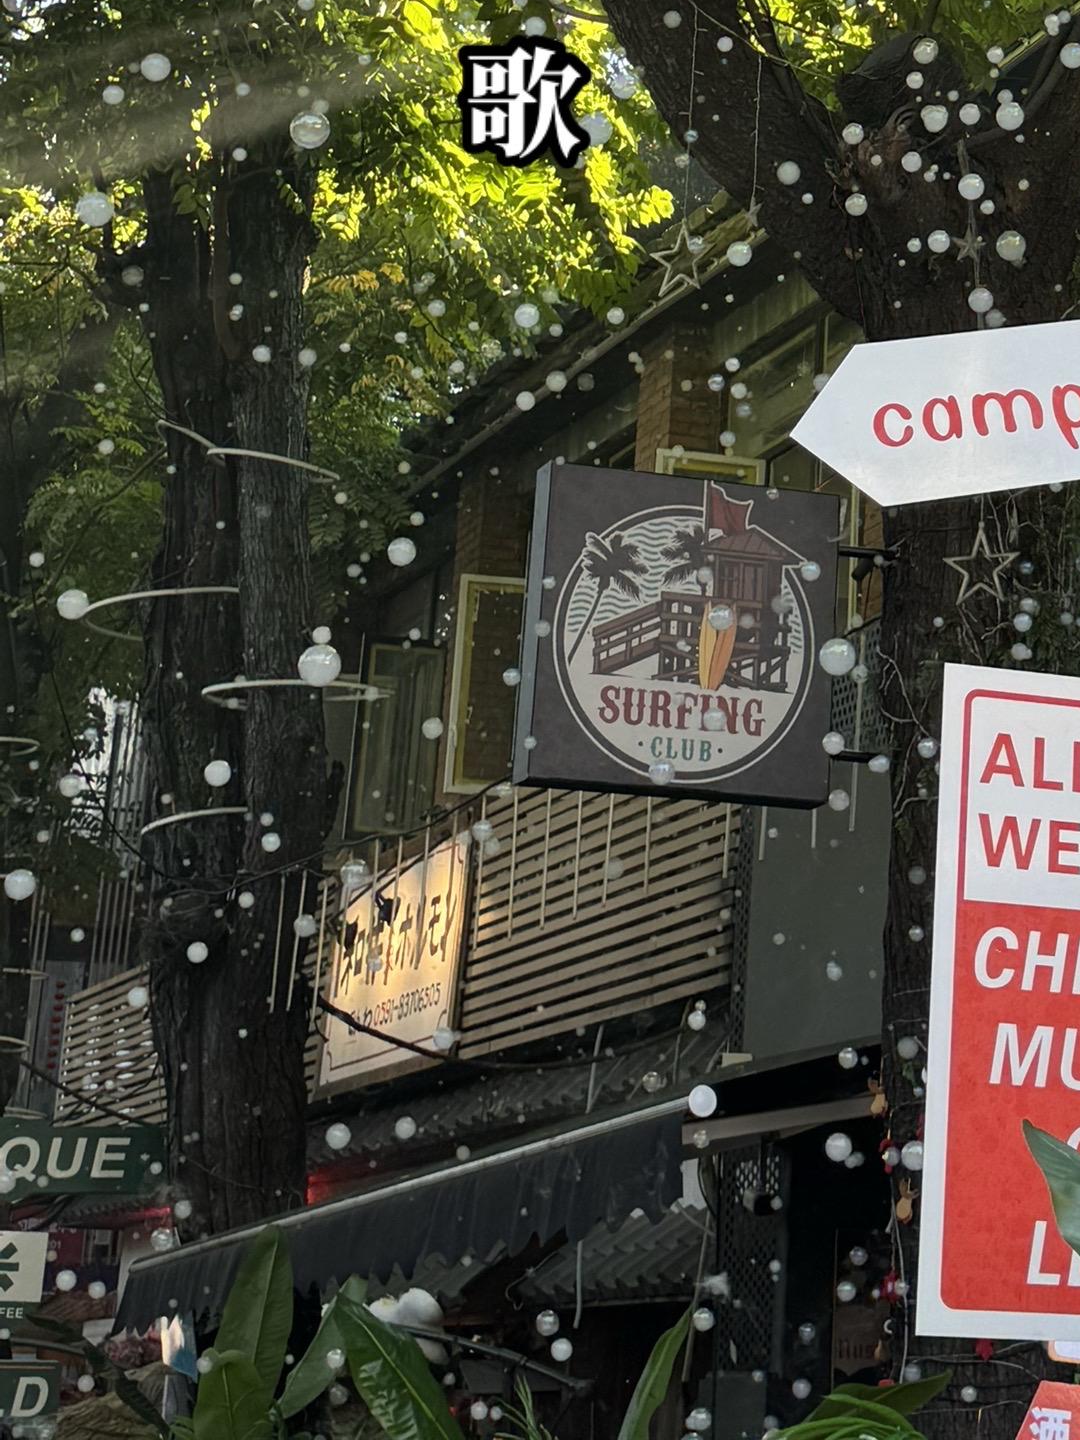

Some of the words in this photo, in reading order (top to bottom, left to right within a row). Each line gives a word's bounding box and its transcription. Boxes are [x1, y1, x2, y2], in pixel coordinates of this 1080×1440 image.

[598, 685, 765, 736] SURFING
[651, 736, 712, 762] CLUB
[0, 1136, 131, 1182] QUE
